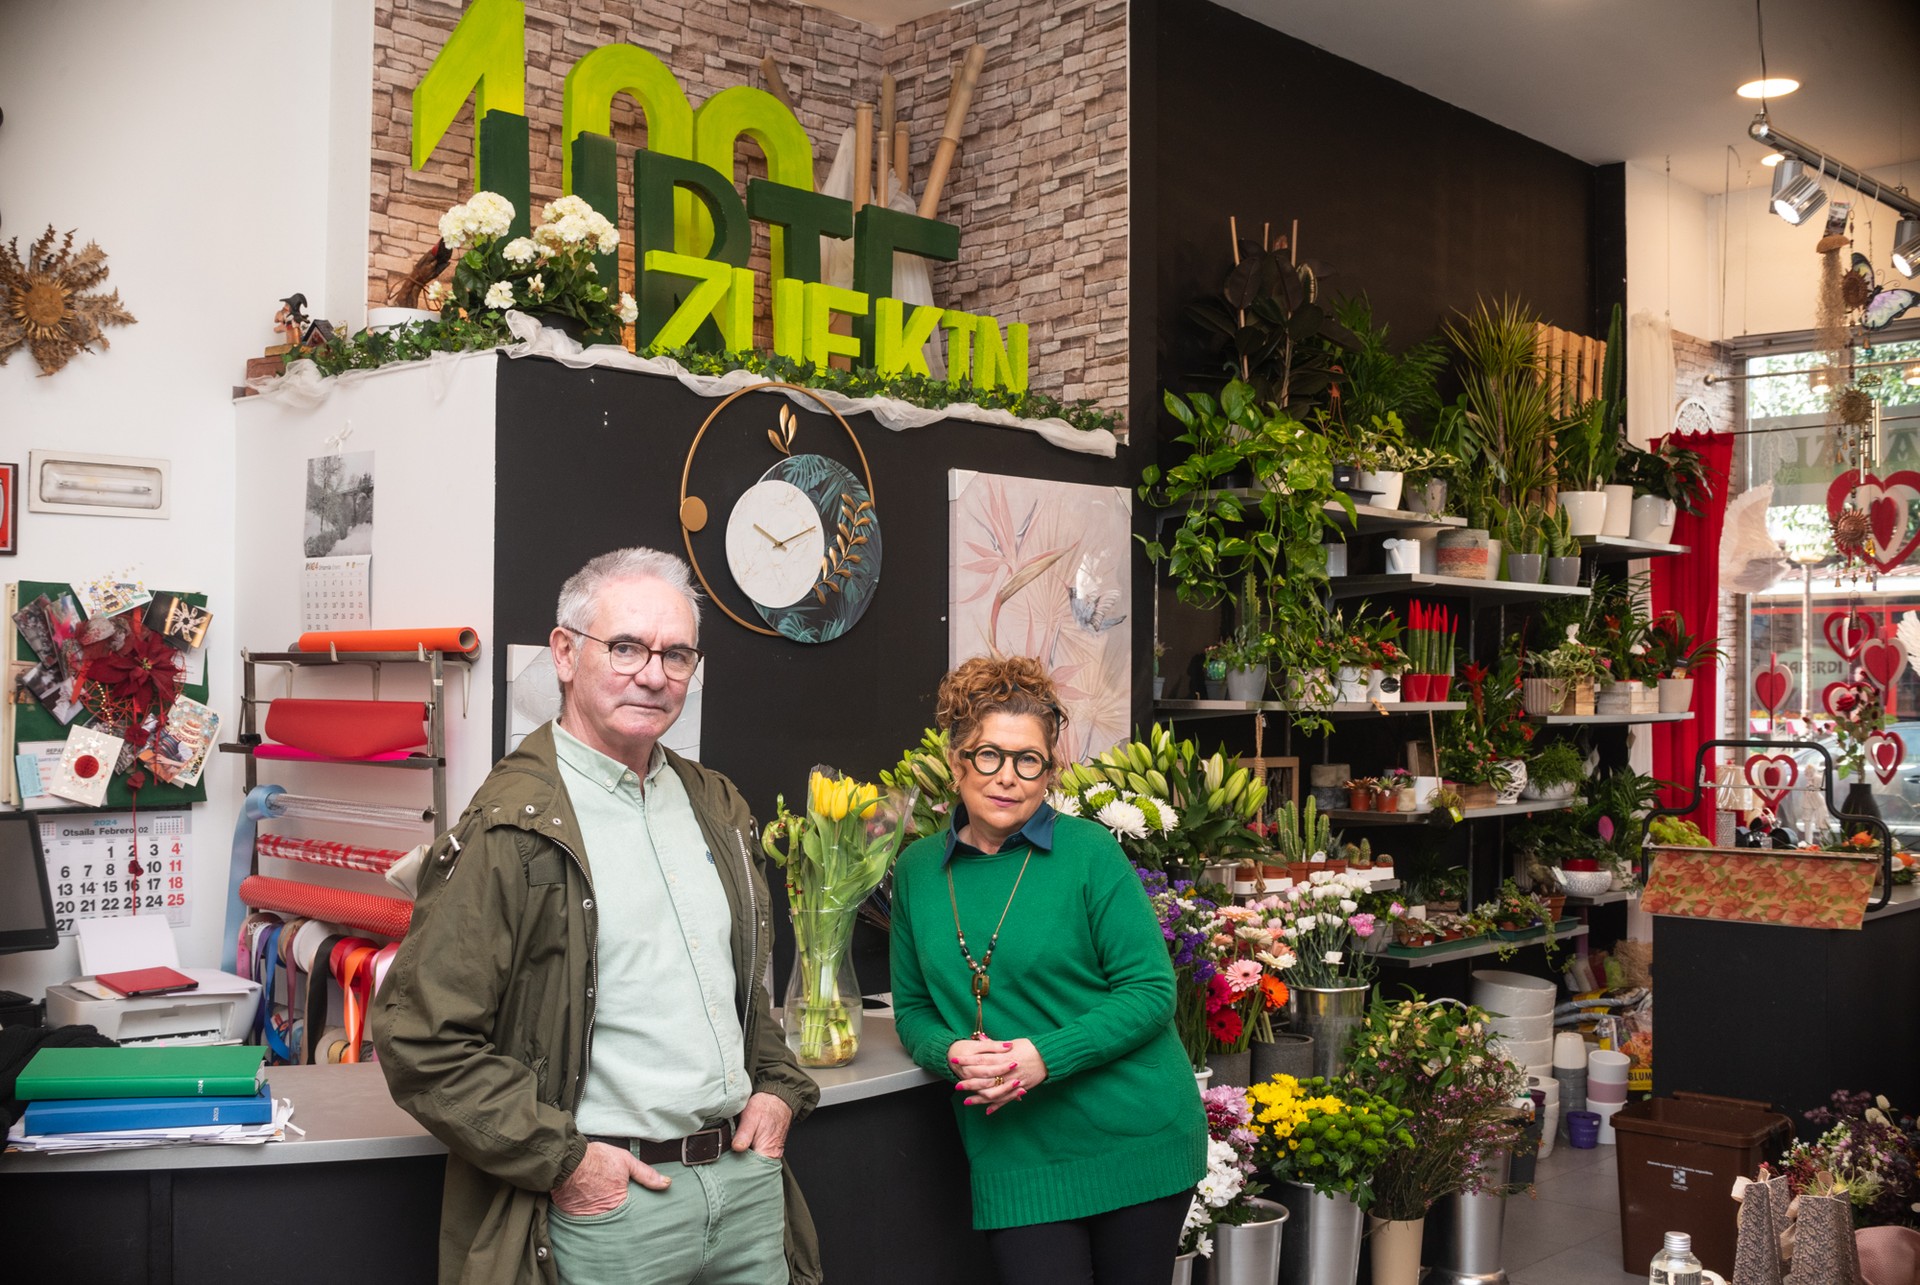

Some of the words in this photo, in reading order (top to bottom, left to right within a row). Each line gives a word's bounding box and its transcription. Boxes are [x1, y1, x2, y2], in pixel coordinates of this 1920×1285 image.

[99, 827, 134, 835] Febrero
[107, 846, 113, 858] 1
[128, 845, 137, 857] 2
[150, 844, 159, 856] 3
[172, 842, 180, 854] 4
[61, 866, 70, 878] 6
[84, 865, 92, 877] 7
[106, 864, 115, 876] 8
[147, 861, 162, 873] 10
[170, 860, 181, 872] 11
[58, 884, 73, 896] 13
[80, 882, 96, 894] 14
[103, 881, 118, 893] 15
[125, 880, 140, 892] 16
[147, 878, 161, 890] 17
[169, 877, 183, 889] 18
[56, 901, 75, 914] 20
[80, 900, 96, 912] 21
[101, 898, 119, 910] 22
[124, 897, 141, 909] 23
[146, 895, 163, 907] 24
[167, 894, 185, 906] 25
[57, 919, 74, 931] 27
